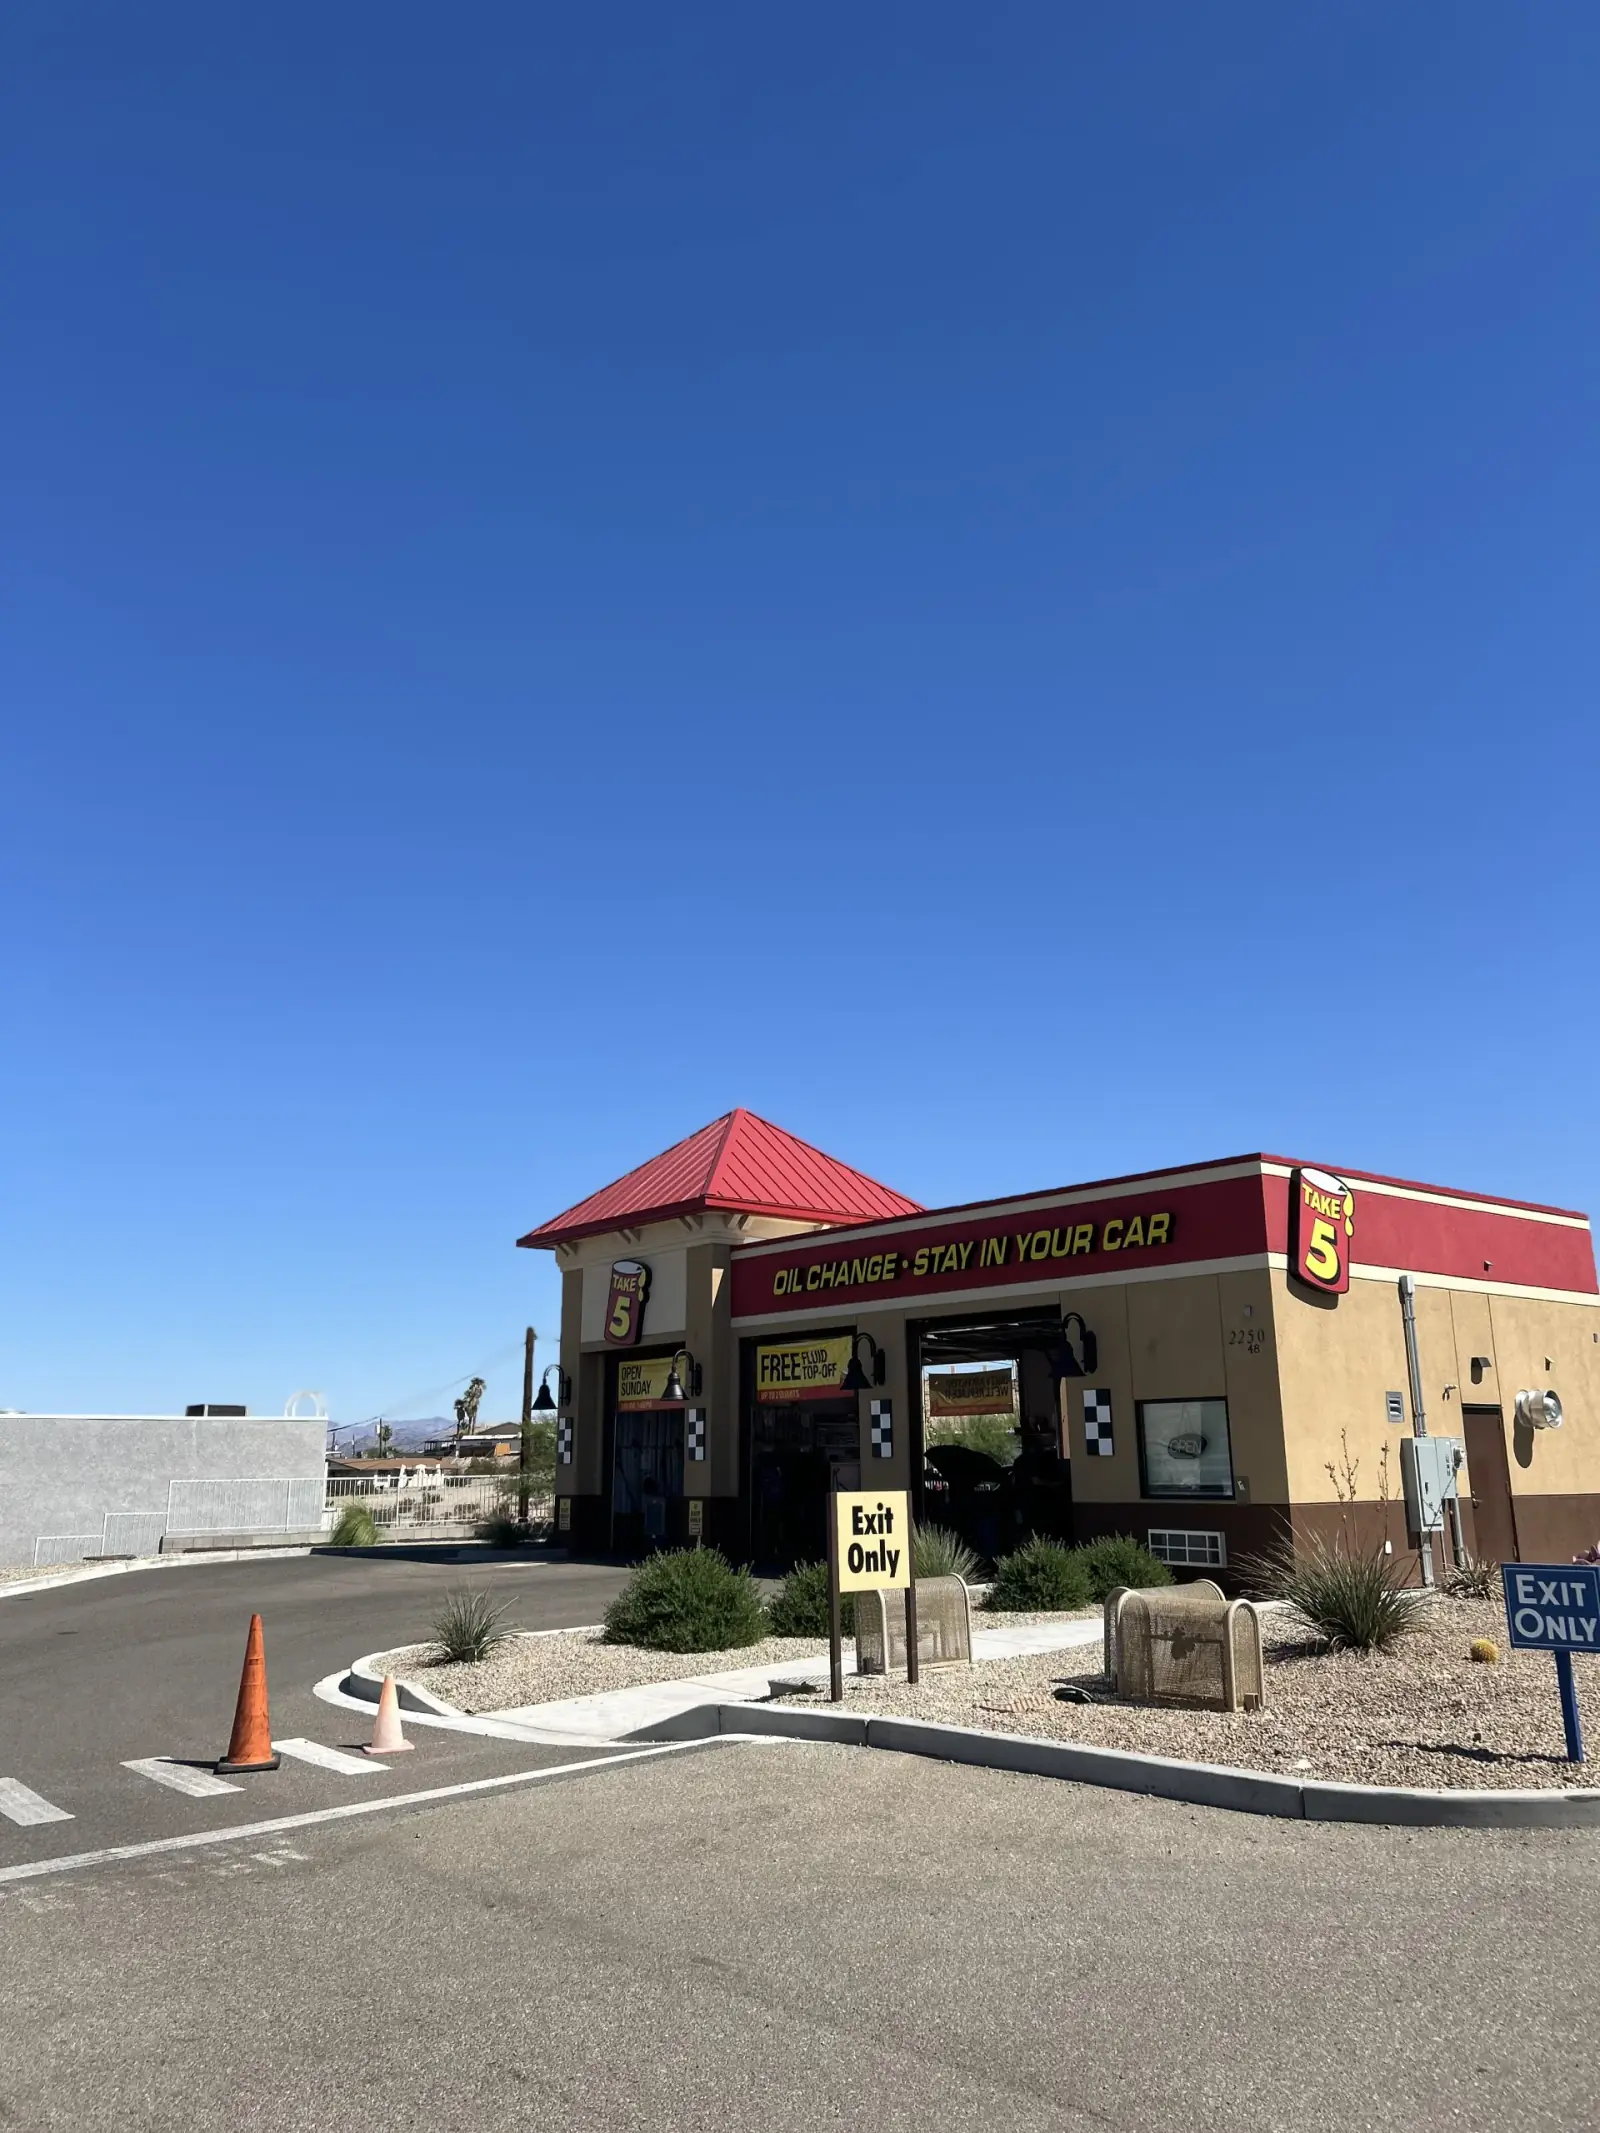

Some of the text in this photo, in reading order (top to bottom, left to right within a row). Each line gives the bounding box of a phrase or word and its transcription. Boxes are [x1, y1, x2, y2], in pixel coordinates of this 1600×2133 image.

[1302, 1183, 1342, 1220] TAKE
[773, 1213, 1171, 1296] OIL CHANGE STAY IN YOUR CAR
[1304, 1217, 1341, 1284] 5
[612, 1274, 637, 1292] TAKE
[609, 1295, 631, 1337] 5
[1228, 1329, 1265, 1345] 2250
[621, 1365, 642, 1381] OPEN
[760, 1349, 828, 1382] FREE FLUID
[802, 1363, 837, 1380] TOP-OFF
[621, 1380, 652, 1396] SUNDAY
[1170, 1439, 1202, 1454] OPEN
[852, 1502, 894, 1535] Exit
[847, 1539, 901, 1578] Only
[1515, 1574, 1587, 1607] EXIT
[1514, 1607, 1598, 1643] ONLY
